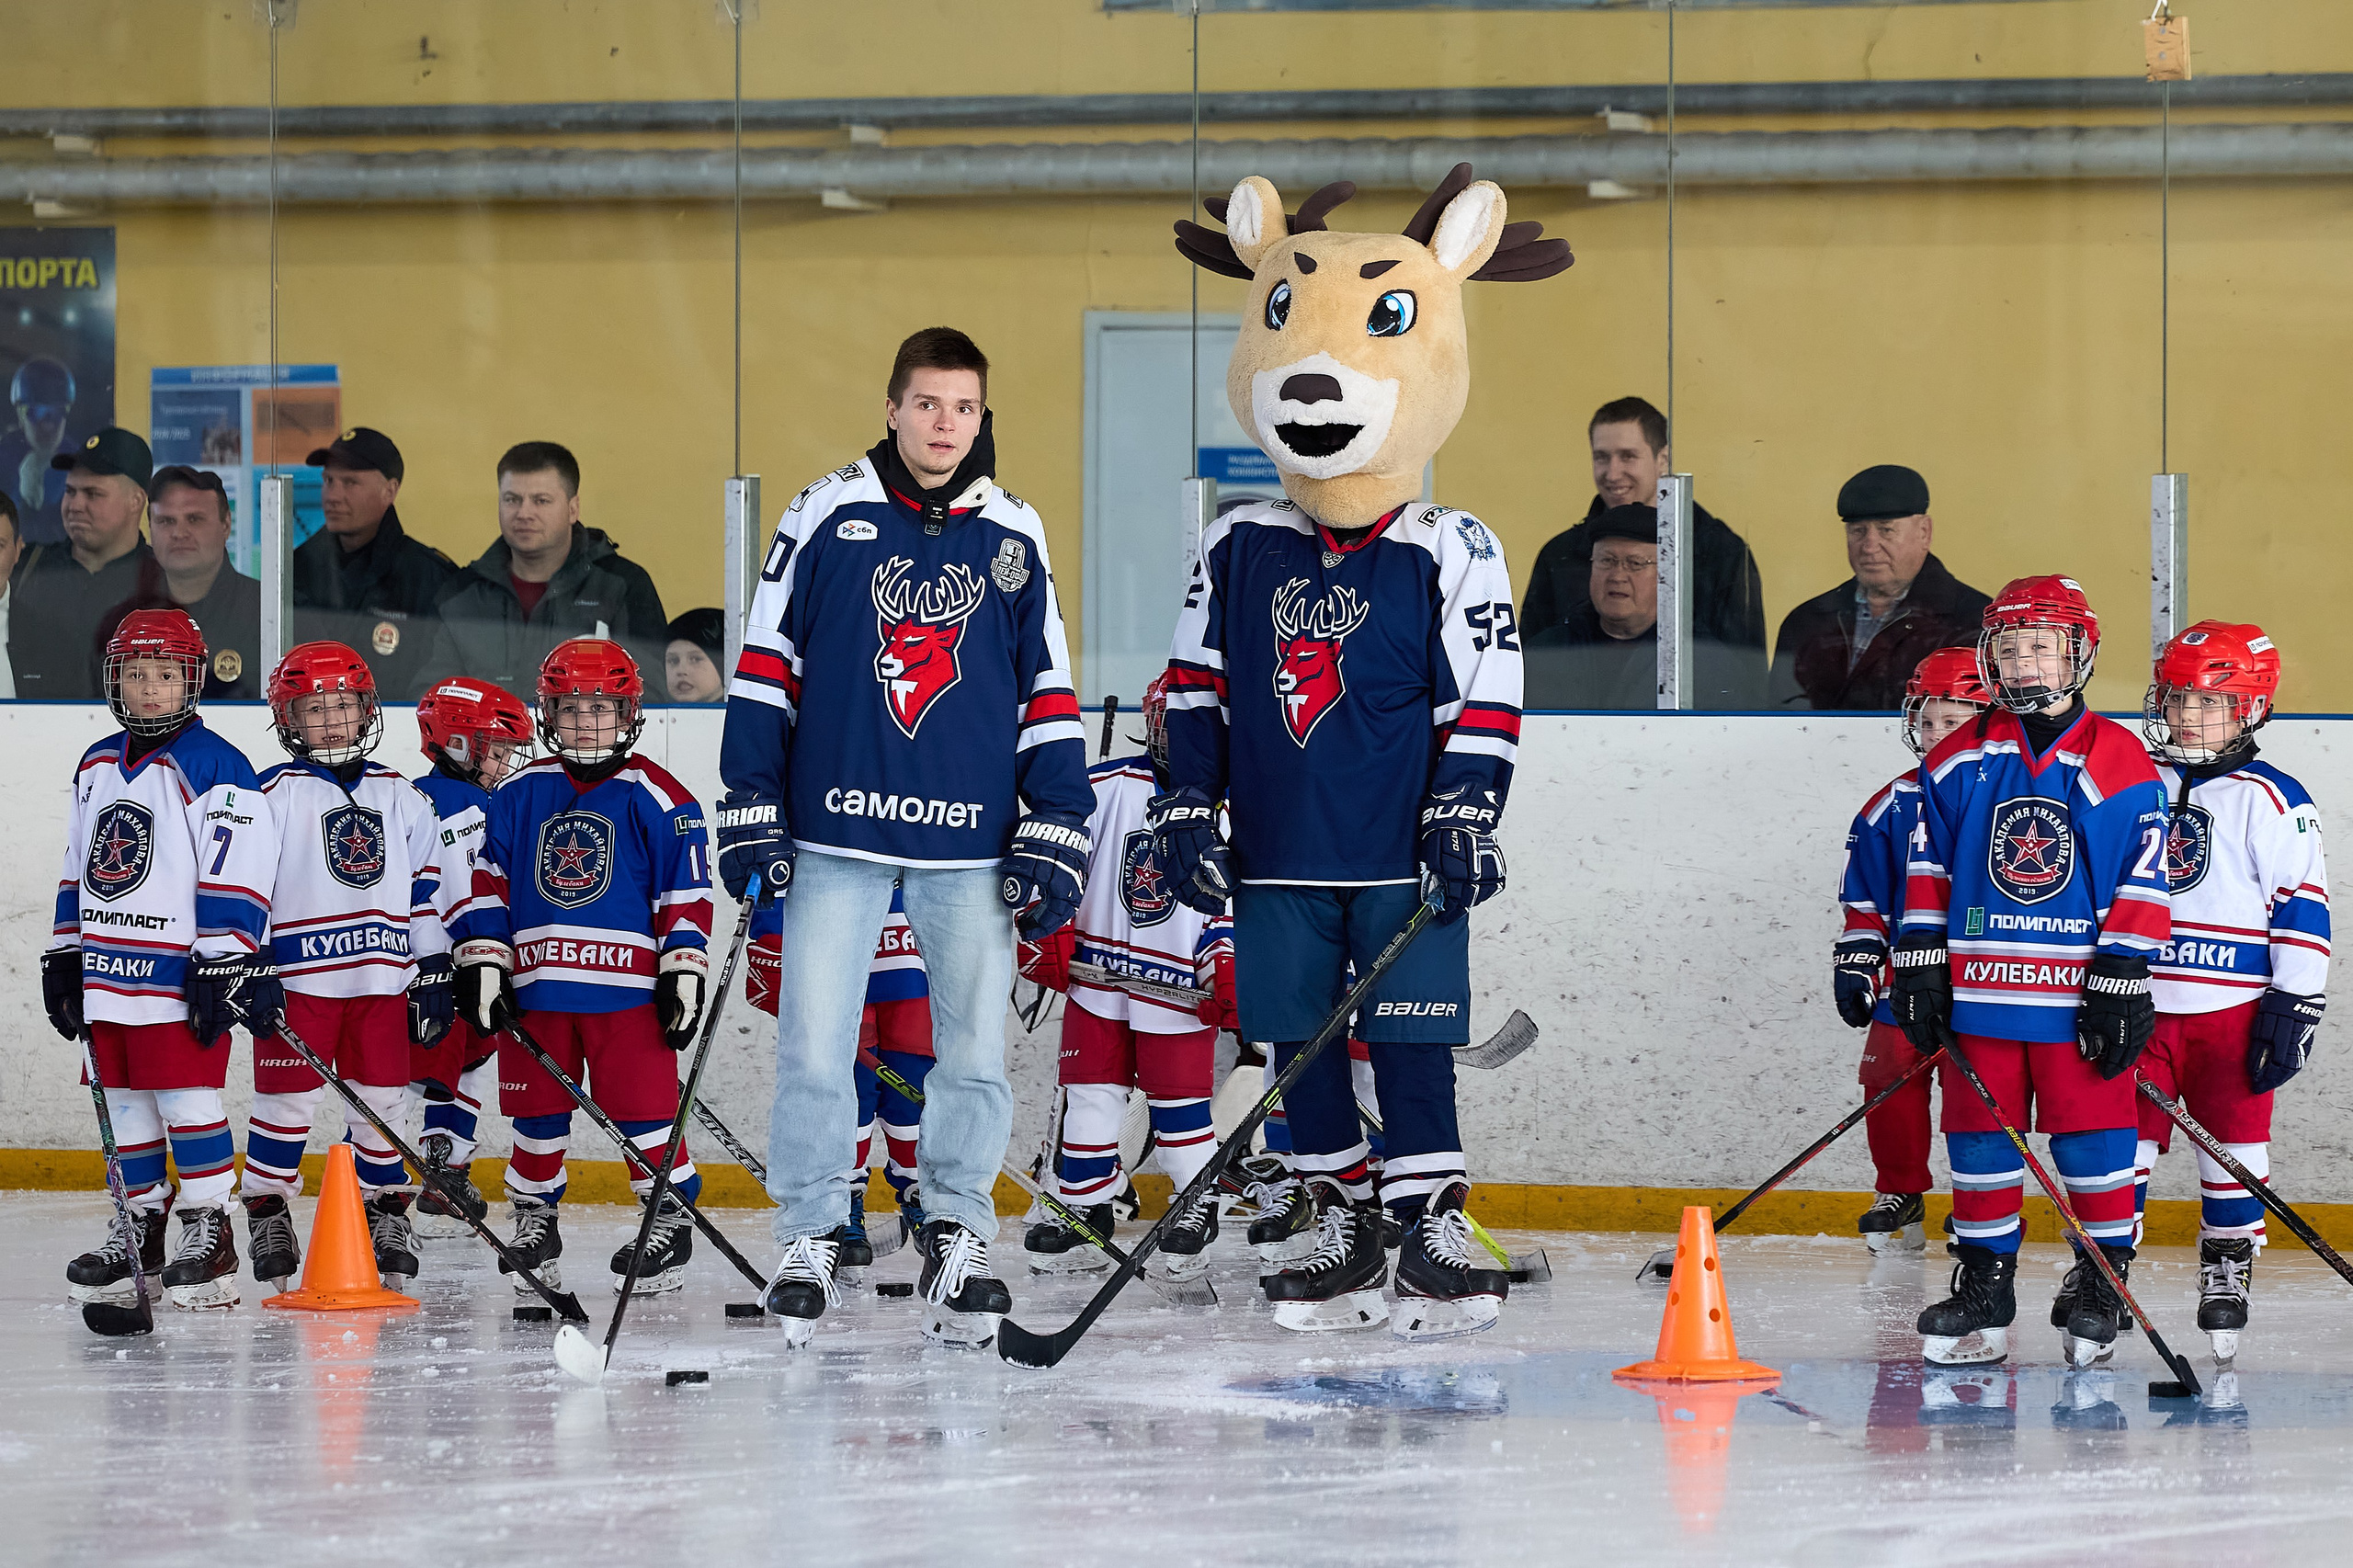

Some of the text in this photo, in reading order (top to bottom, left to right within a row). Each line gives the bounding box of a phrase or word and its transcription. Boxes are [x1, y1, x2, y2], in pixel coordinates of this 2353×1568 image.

[1996, 603, 2032, 612] BAUER
[1464, 601, 1521, 653] 52
[824, 787, 983, 829] самолет
[1421, 804, 1495, 825] AUER
[573, 821, 608, 872] МИХАЙЛОВА
[1994, 806, 2070, 865] АКАДЕМИЯ МИХАЙЛОВА
[209, 824, 233, 876] 7
[81, 908, 169, 930] ОЛИПЛАСТ
[1989, 914, 2093, 934] ПОЛИПЛАСТ
[301, 926, 409, 959] КУЛЕБАКИ
[82, 952, 156, 978] ЕБАКИ
[1963, 961, 2086, 986] КУЛЕБАКИ
[1375, 1001, 1459, 1017] BAUER
[2005, 1125, 2030, 1154] BAUER
